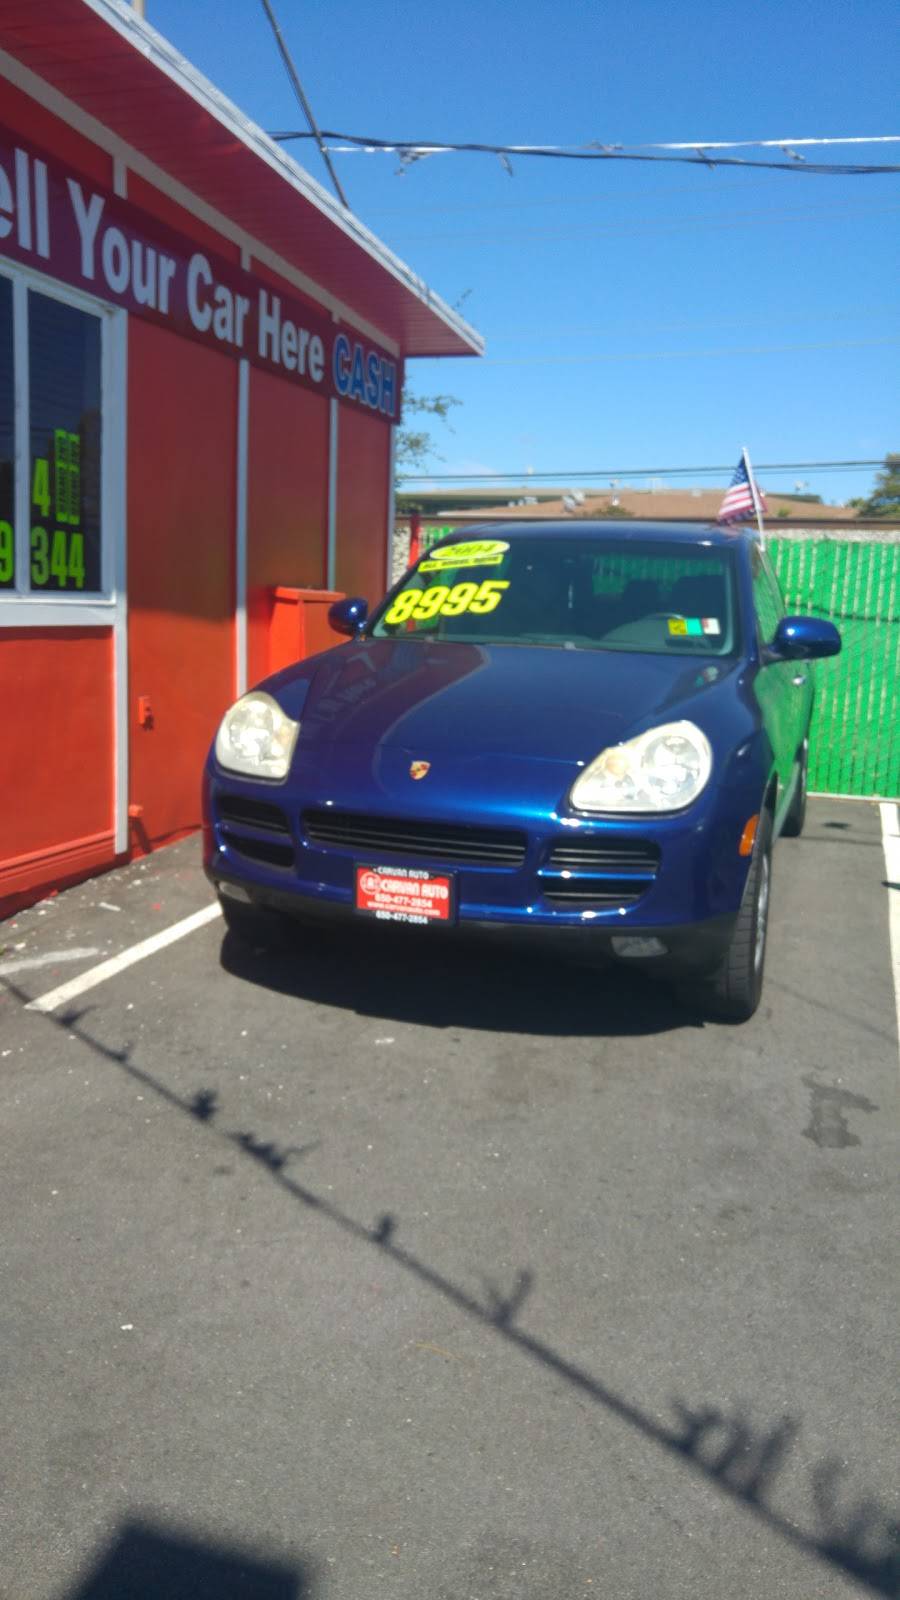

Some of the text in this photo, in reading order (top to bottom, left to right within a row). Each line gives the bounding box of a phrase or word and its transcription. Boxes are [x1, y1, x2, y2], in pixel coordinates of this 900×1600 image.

[66, 178, 176, 315] Your
[187, 253, 250, 348] Car
[257, 288, 325, 383] Here
[332, 334, 397, 417] CASH
[33, 458, 50, 517] 4
[31, 526, 85, 588] 344
[385, 580, 510, 624] 8995
[408, 869, 430, 880] AUTO
[421, 883, 449, 899] AUTO
